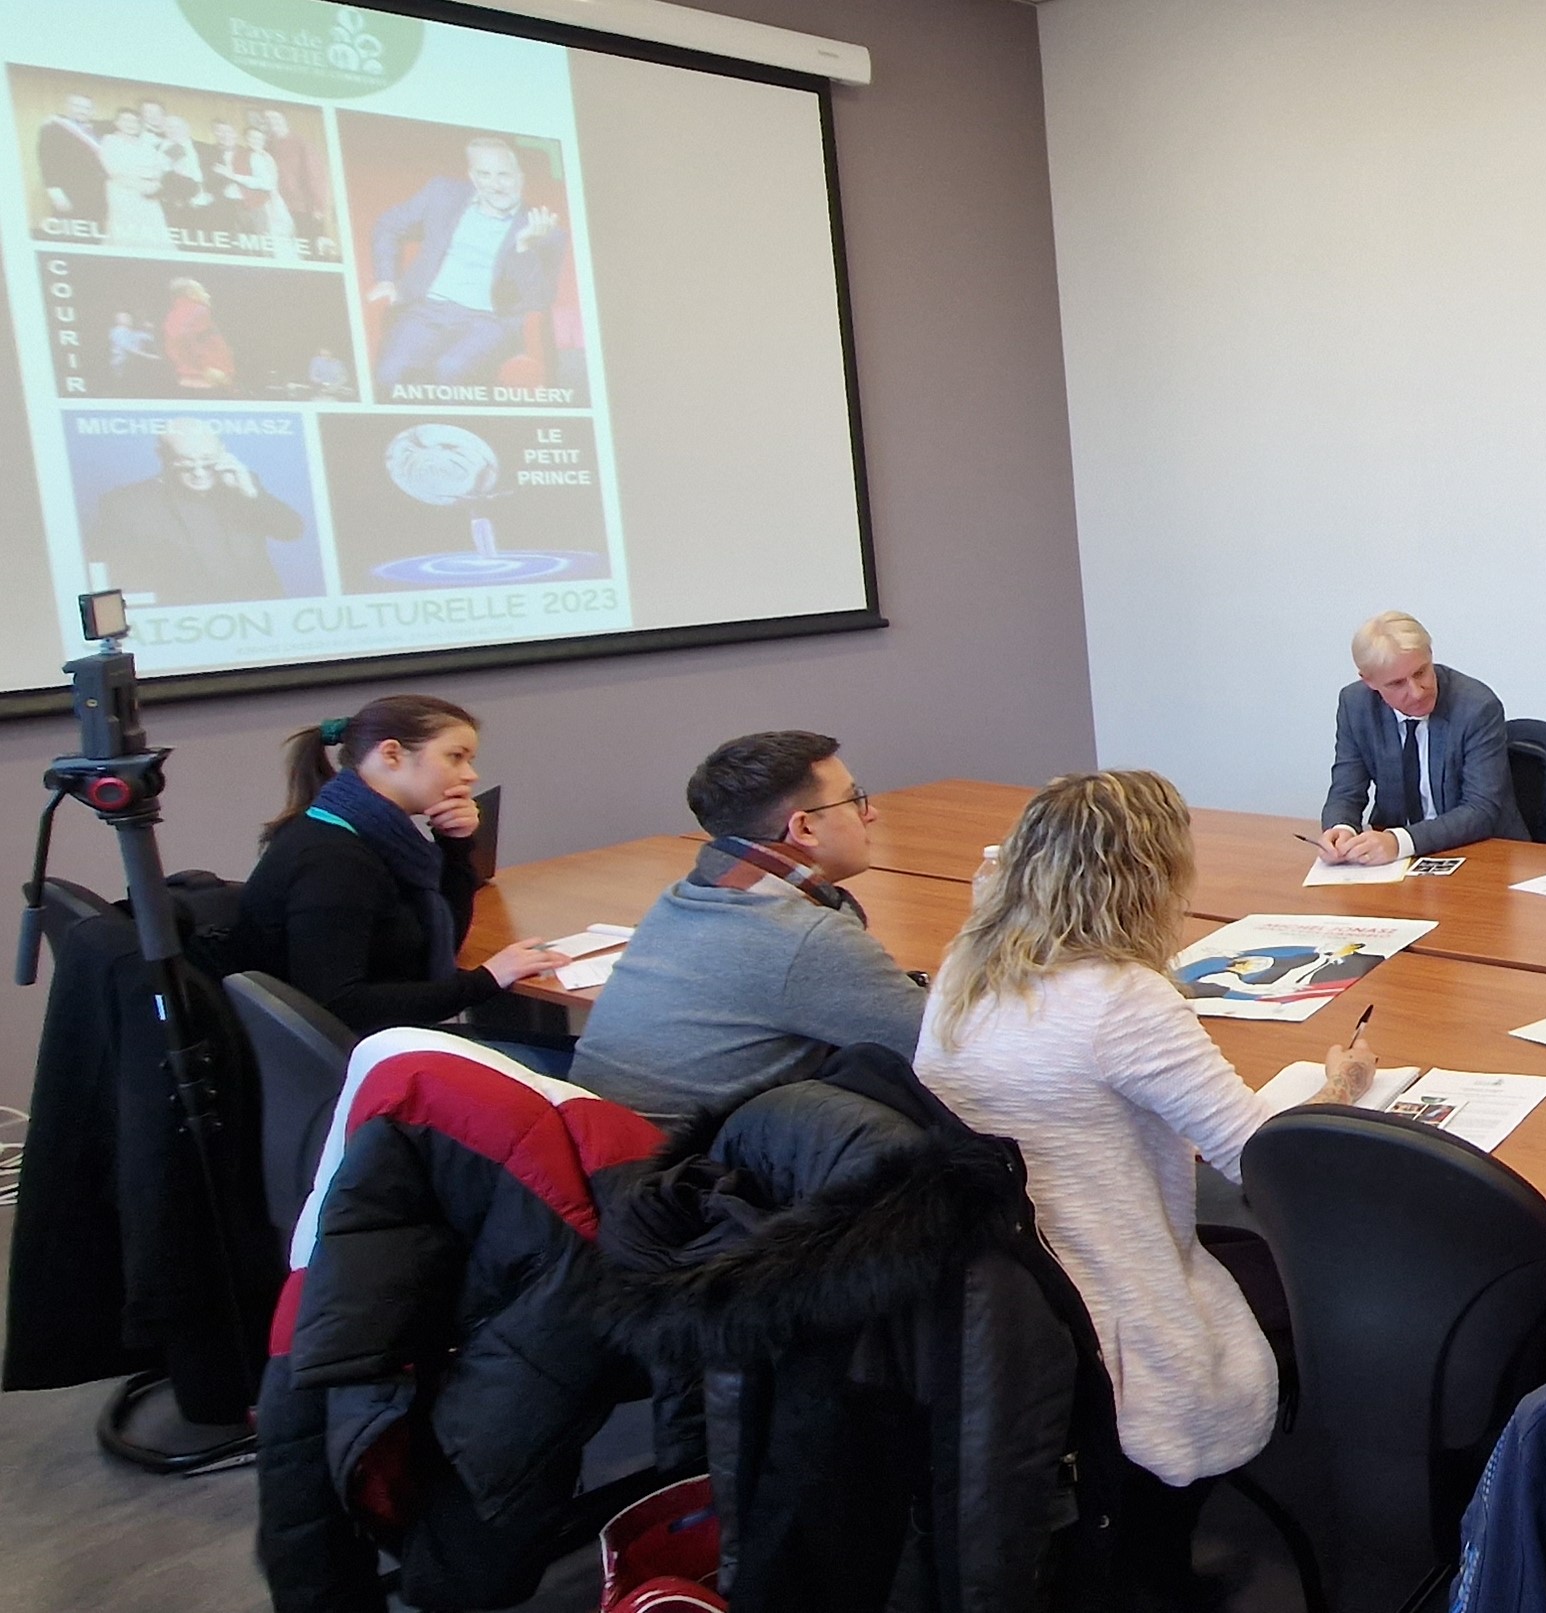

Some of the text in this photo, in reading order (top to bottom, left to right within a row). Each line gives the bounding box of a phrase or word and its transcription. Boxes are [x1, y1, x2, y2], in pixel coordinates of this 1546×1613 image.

[392, 384, 489, 402] ANTOINE
[536, 428, 563, 444] LE
[523, 448, 581, 465] PETIT
[517, 469, 592, 486] PRINCE
[126, 612, 273, 647] AISON
[291, 593, 527, 636] CULTURELLE
[542, 587, 619, 616] 2023
